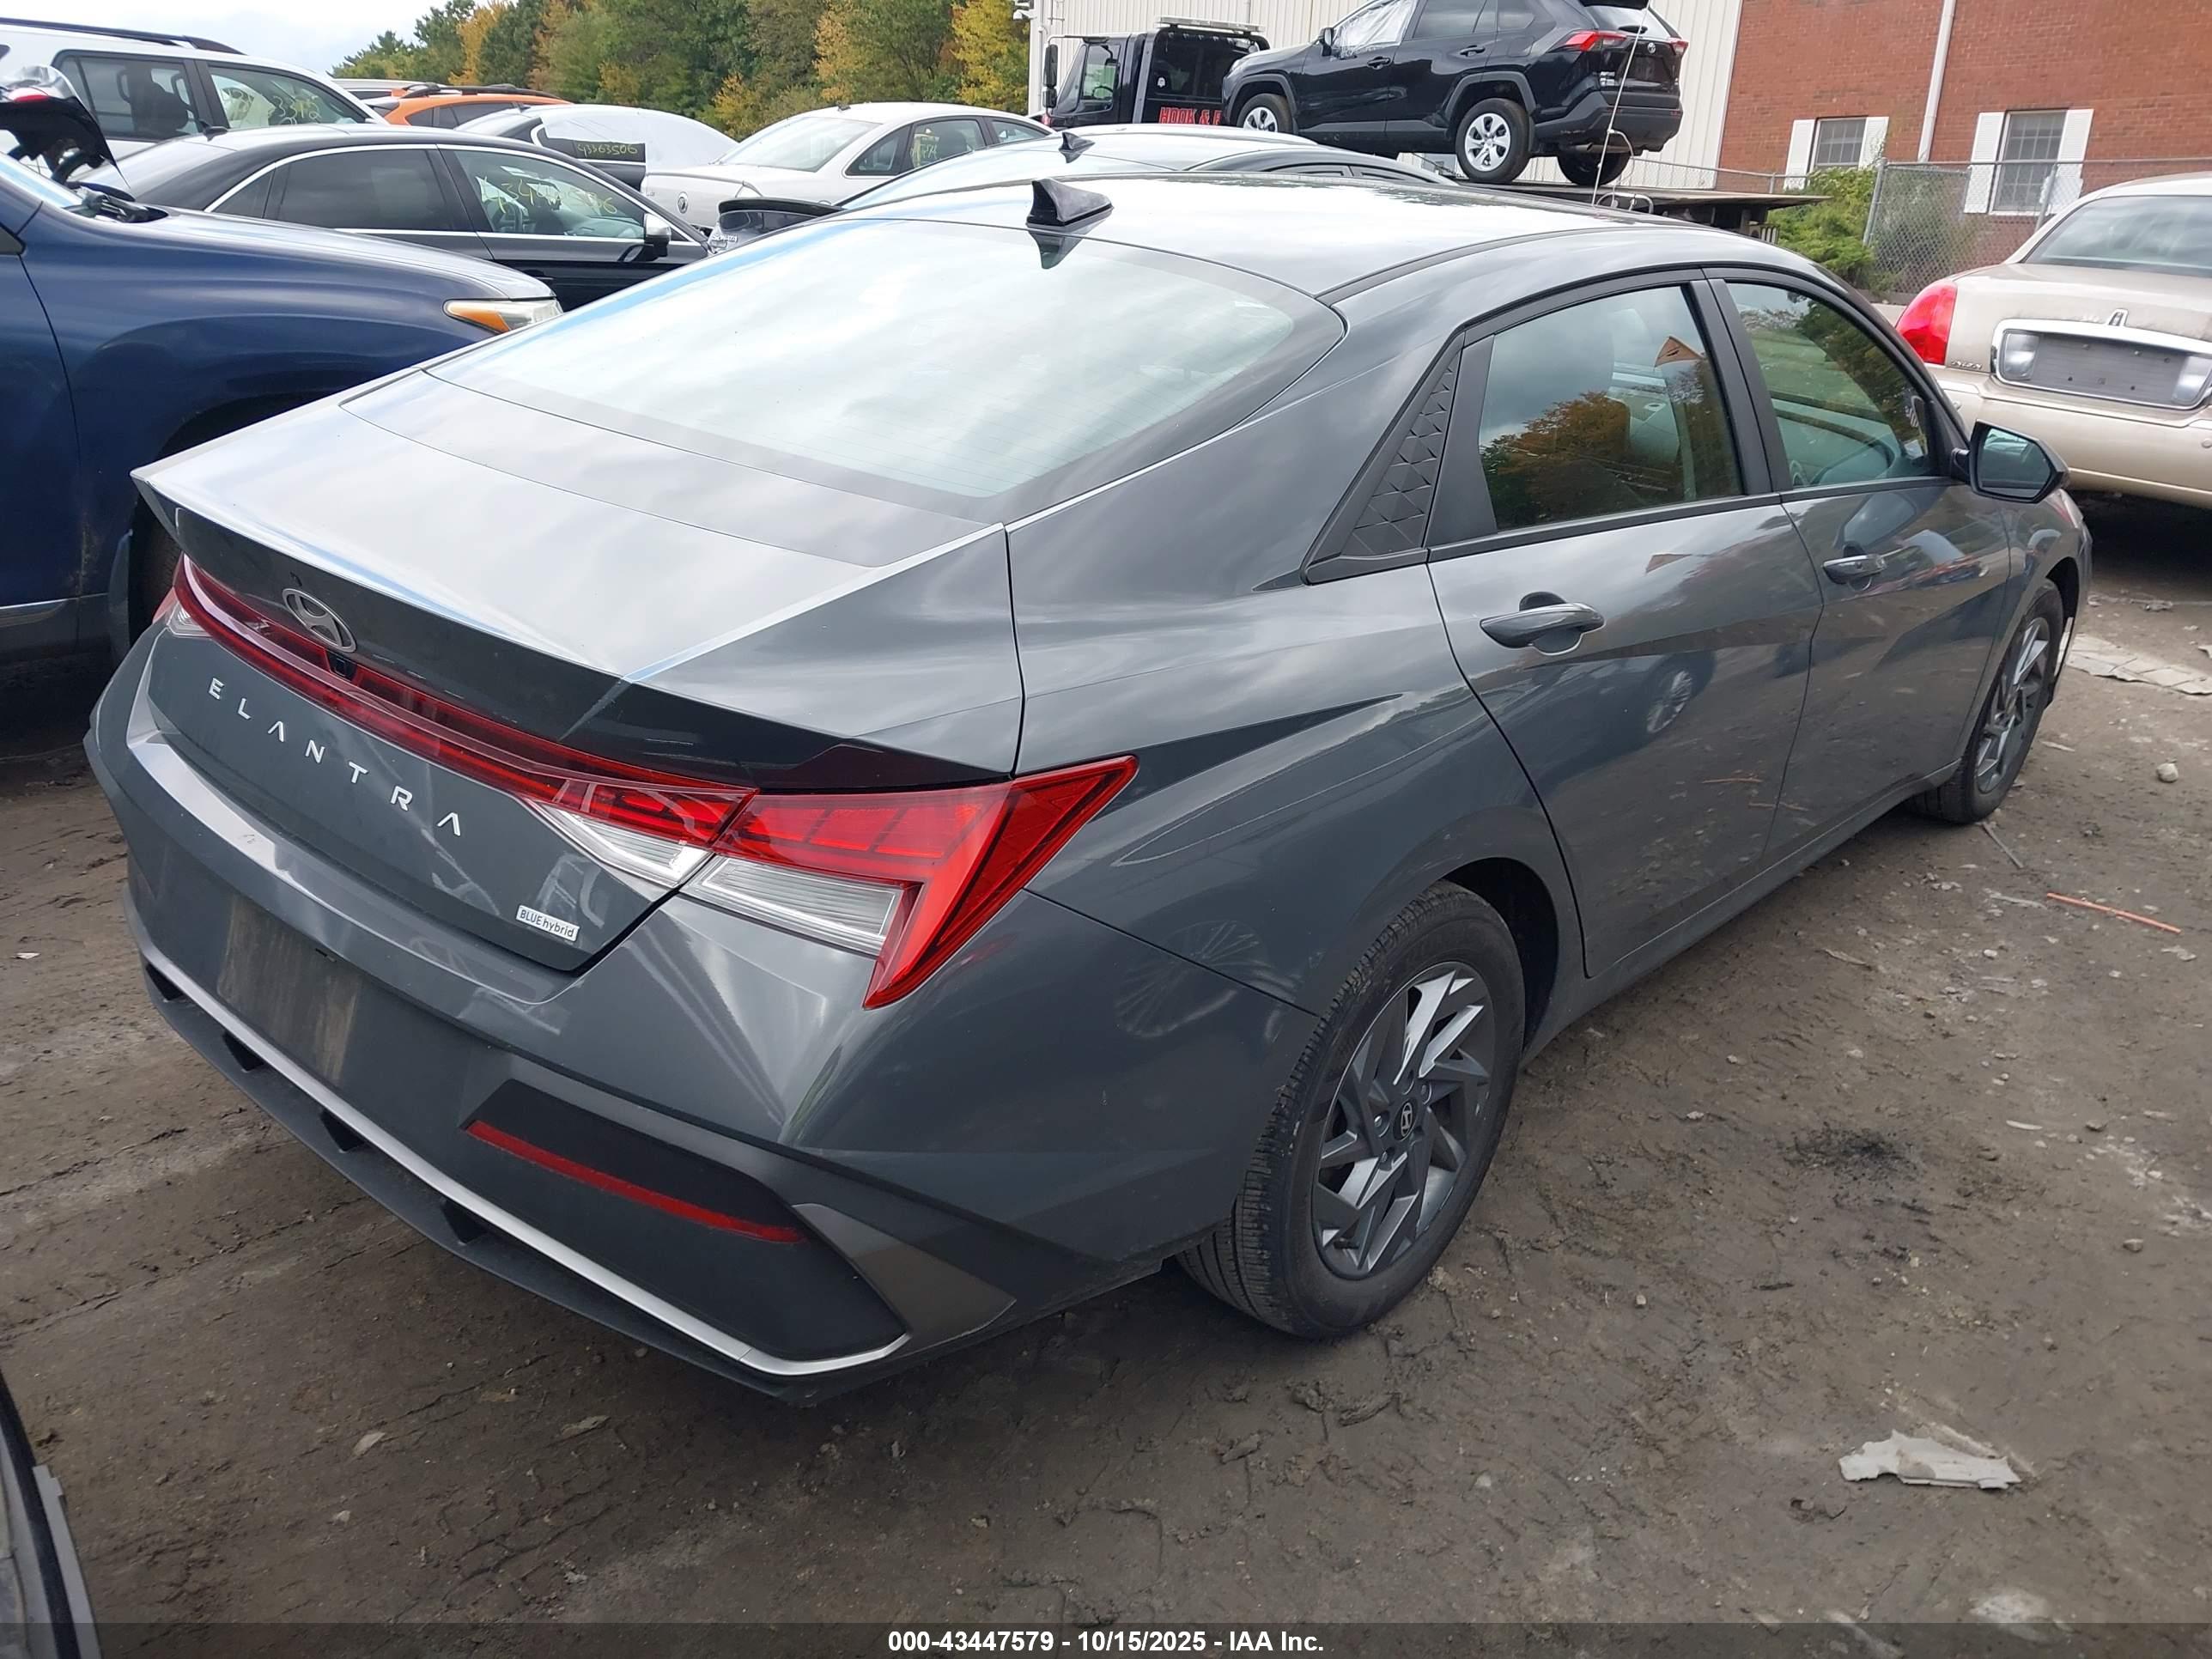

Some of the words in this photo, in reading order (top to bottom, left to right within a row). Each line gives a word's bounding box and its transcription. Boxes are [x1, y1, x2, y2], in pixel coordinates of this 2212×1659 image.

[1159, 106, 1196, 125] HOOK
[208, 677, 461, 837] ELANTRA
[520, 909, 543, 926] BLUE
[542, 918, 574, 938] hybrid
